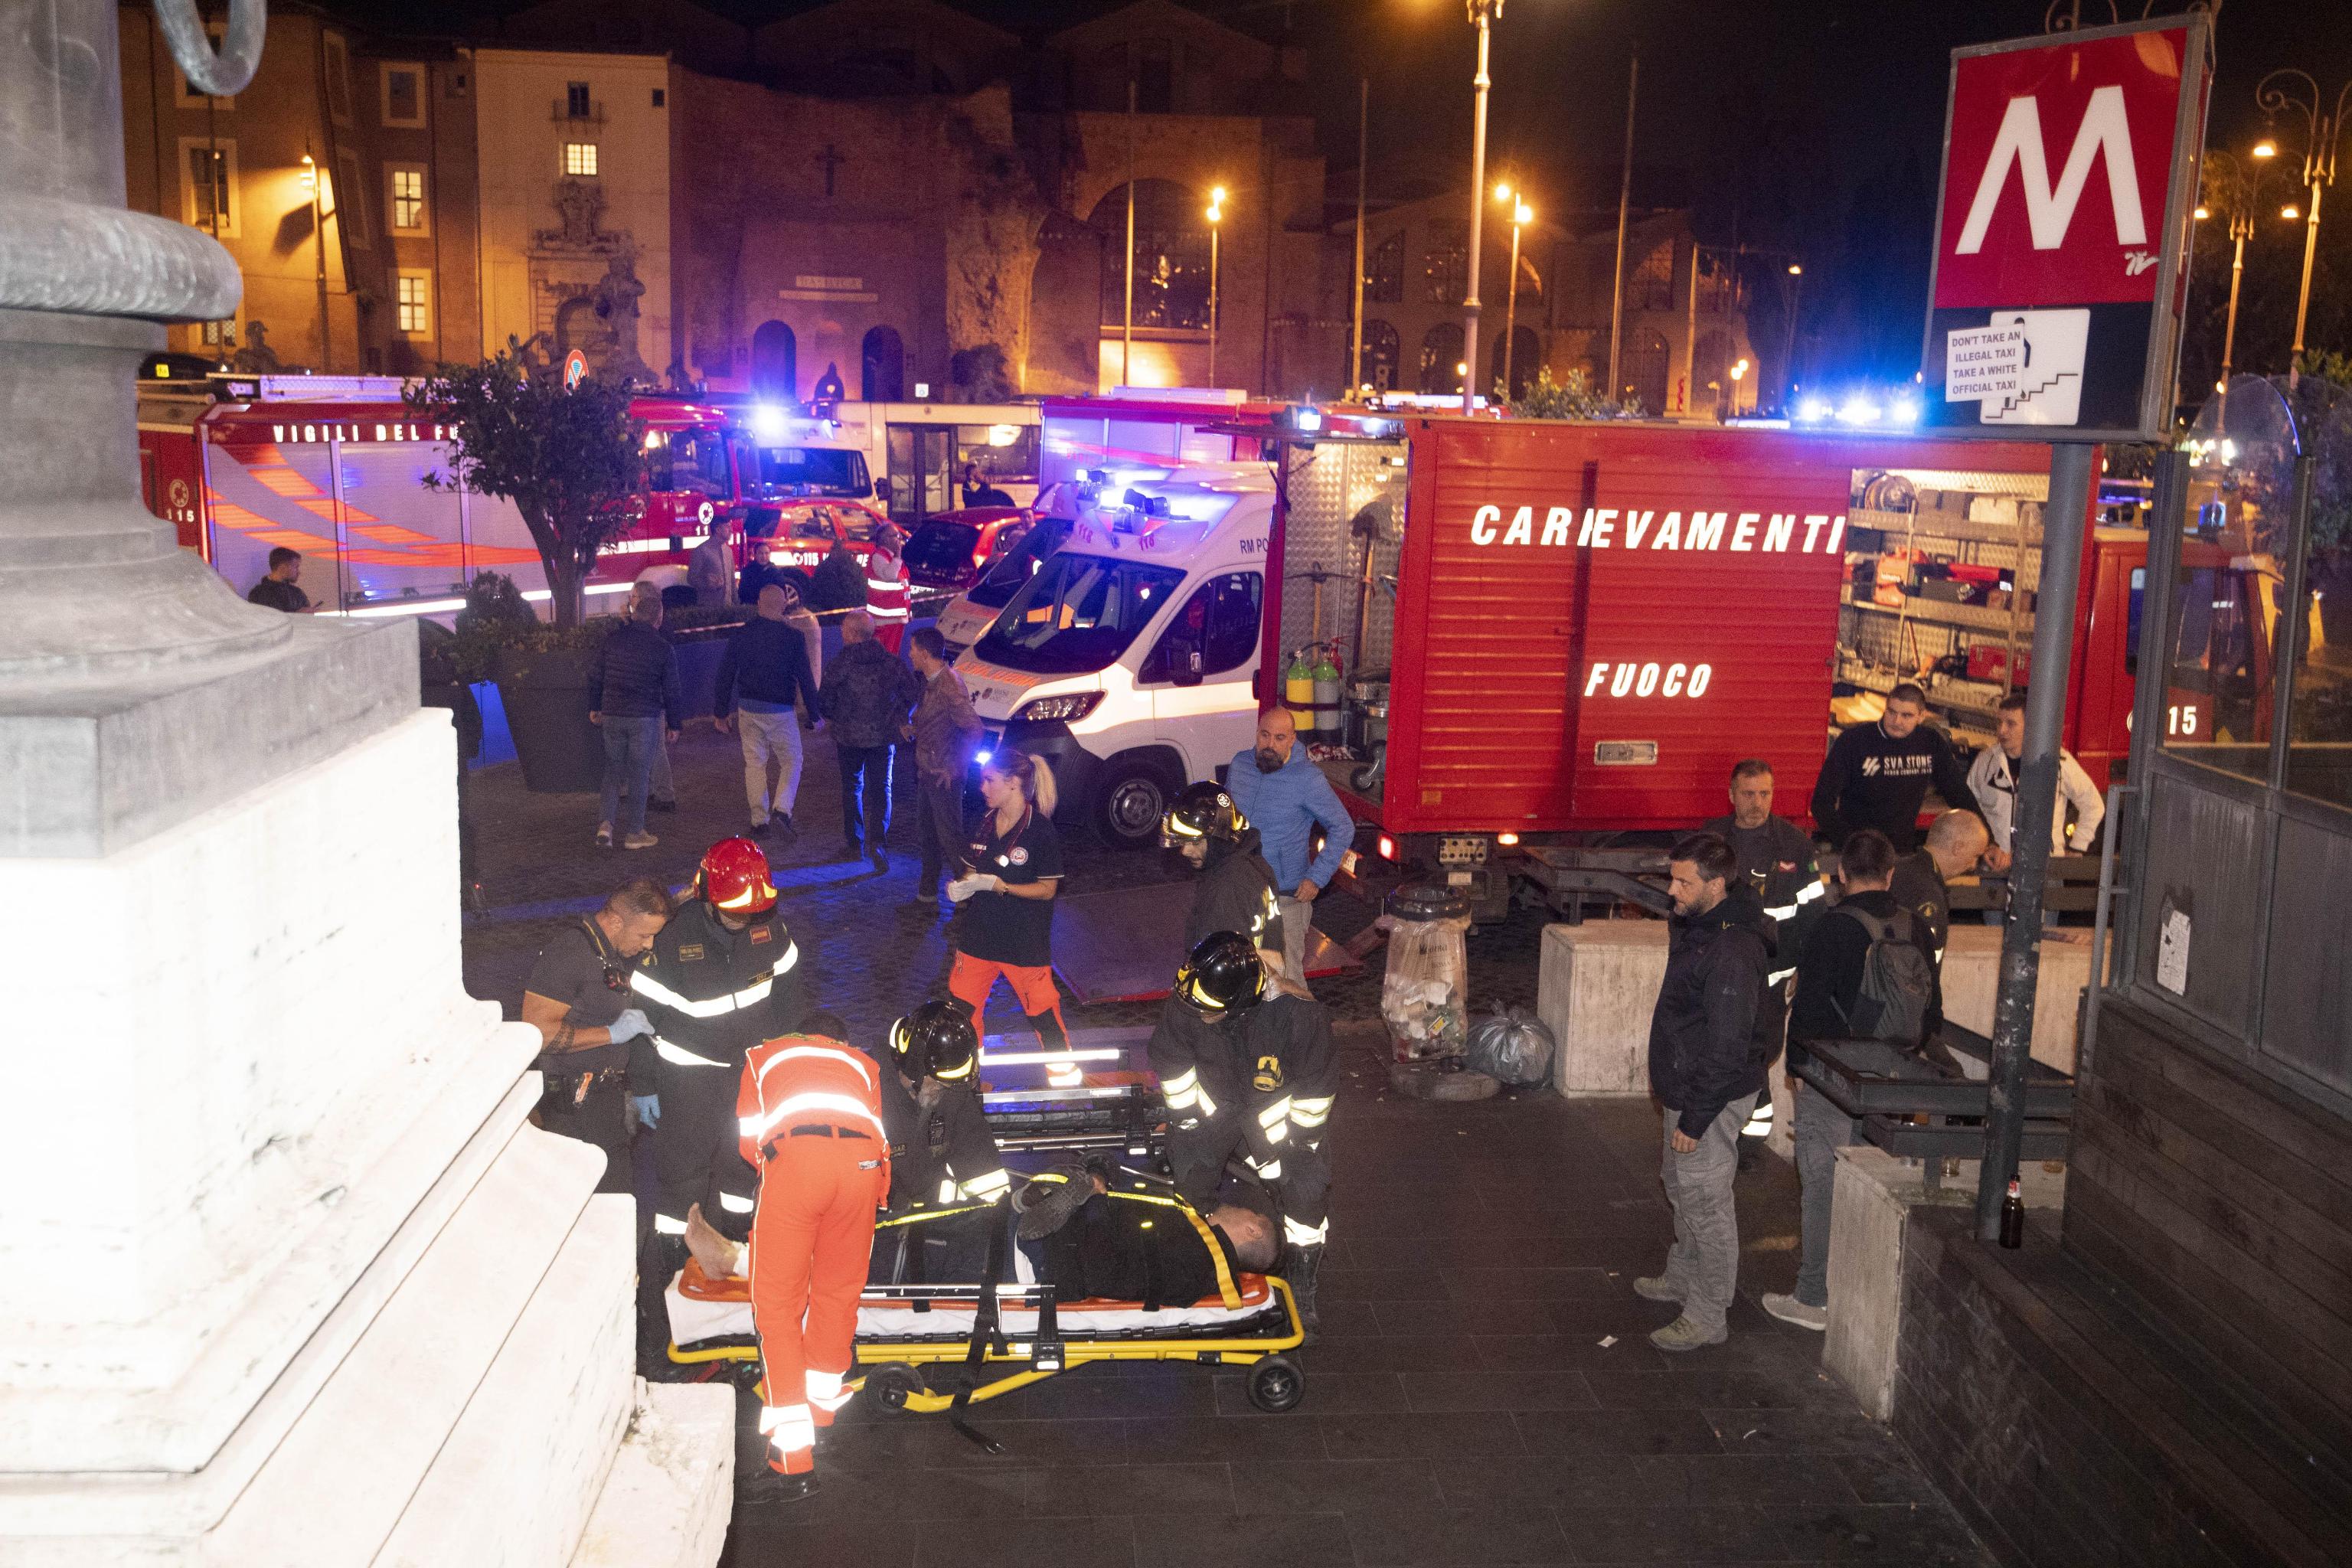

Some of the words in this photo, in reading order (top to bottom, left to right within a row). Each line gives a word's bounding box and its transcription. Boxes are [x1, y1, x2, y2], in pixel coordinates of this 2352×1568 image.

[1955, 85, 2147, 255] M
[1952, 335, 1978, 347] DON'T
[1981, 333, 2005, 344] TAKE
[2007, 331, 2020, 341] AN
[1955, 351, 1992, 362] ILLEGAL
[1995, 348, 2016, 358] TAXI
[1953, 368, 1976, 378] TAKE
[1978, 368, 1985, 376] A
[1988, 364, 2017, 375] WHITE
[1952, 383, 1993, 394] OFFICIAL
[1995, 381, 2016, 390] TAXI
[273, 424, 359, 443] VIGILI
[376, 424, 420, 441] DEL
[435, 424, 459, 440] FU
[166, 508, 194, 522] 115
[1240, 539, 1255, 555] RM
[1256, 537, 1269, 552] PO
[803, 552, 819, 567] 115
[1584, 663, 1712, 698] FUOCO
[2168, 705, 2197, 735] 15
[1884, 756, 1903, 769] SVA
[1906, 754, 1932, 768] STONE
